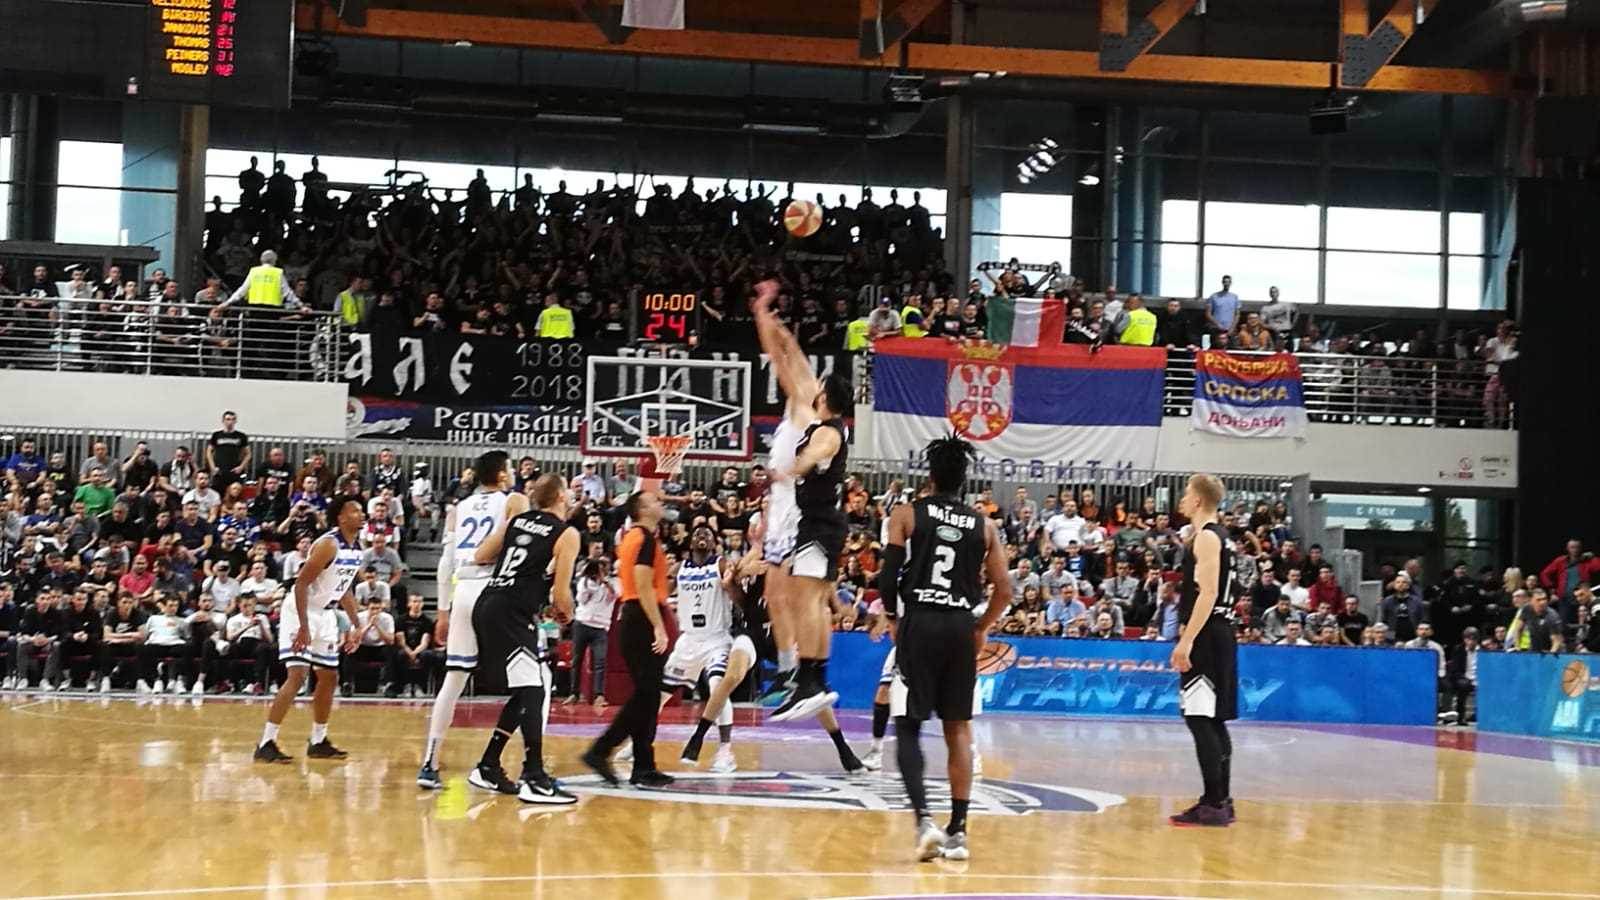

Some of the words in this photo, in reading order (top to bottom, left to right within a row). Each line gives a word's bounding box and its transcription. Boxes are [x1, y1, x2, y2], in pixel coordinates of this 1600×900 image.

[174, 35, 210, 48] THOMAS
[645, 293, 695, 311] 10:00
[645, 313, 686, 340] 24
[516, 342, 582, 367] 1988
[512, 375, 582, 400] 2018
[1205, 381, 1290, 403] СРПСКА
[927, 503, 976, 530] WALDEN
[457, 515, 494, 549] 22
[499, 545, 528, 577] 12
[930, 544, 956, 589] 2
[913, 588, 972, 610] TESLA
[1005, 672, 1284, 710] FANTAY
